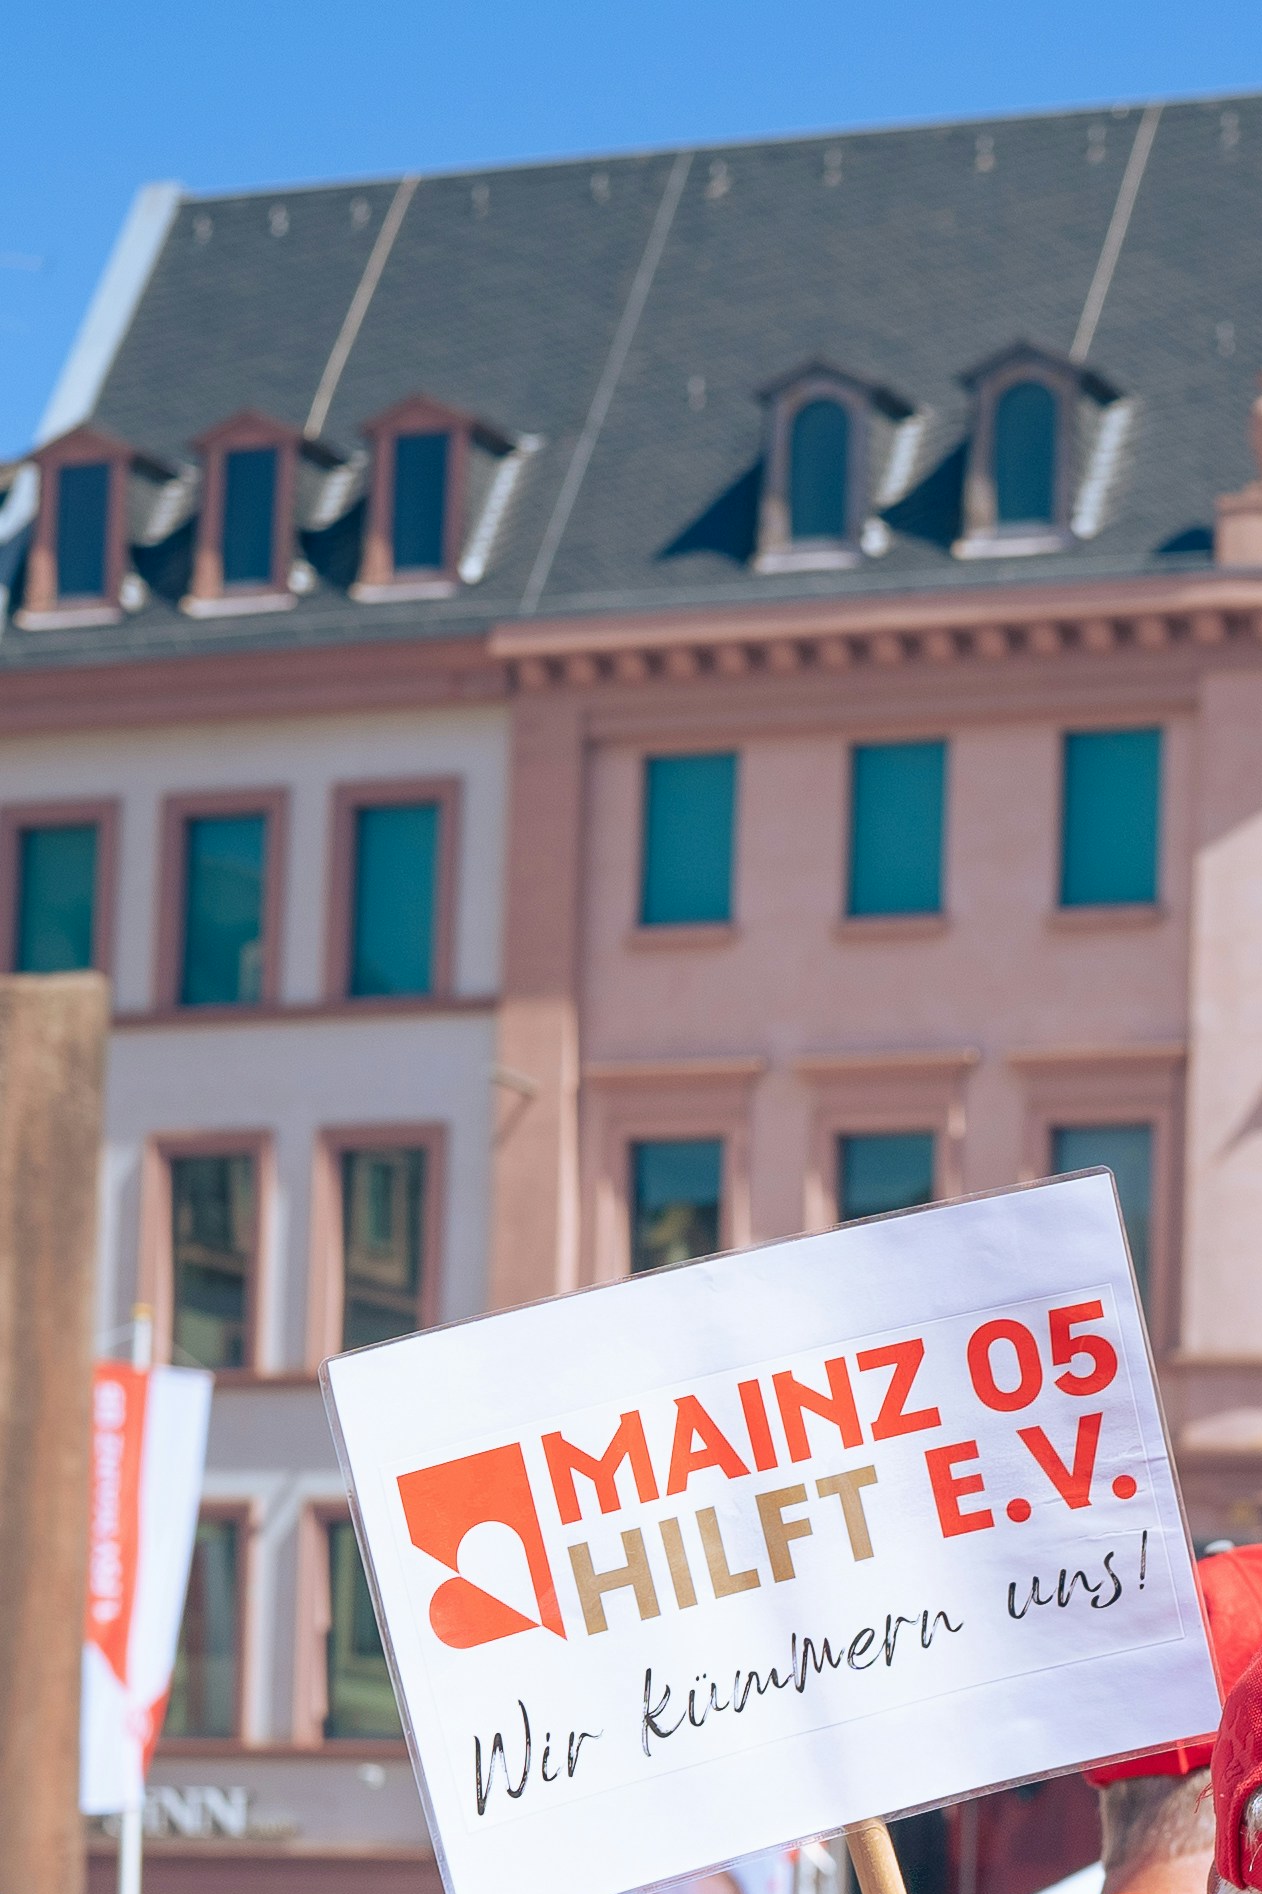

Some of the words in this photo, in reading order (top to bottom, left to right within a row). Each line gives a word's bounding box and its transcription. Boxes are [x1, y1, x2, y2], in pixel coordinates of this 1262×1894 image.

[541, 1337, 942, 1525] MAINZ
[966, 1299, 1119, 1413] 05
[566, 1465, 879, 1637] HILFT
[923, 1411, 1139, 1539] E.V.
[473, 1699, 605, 1817] Wir
[642, 1606, 964, 1758] kümmern
[1006, 1529, 1150, 1620] uns!
